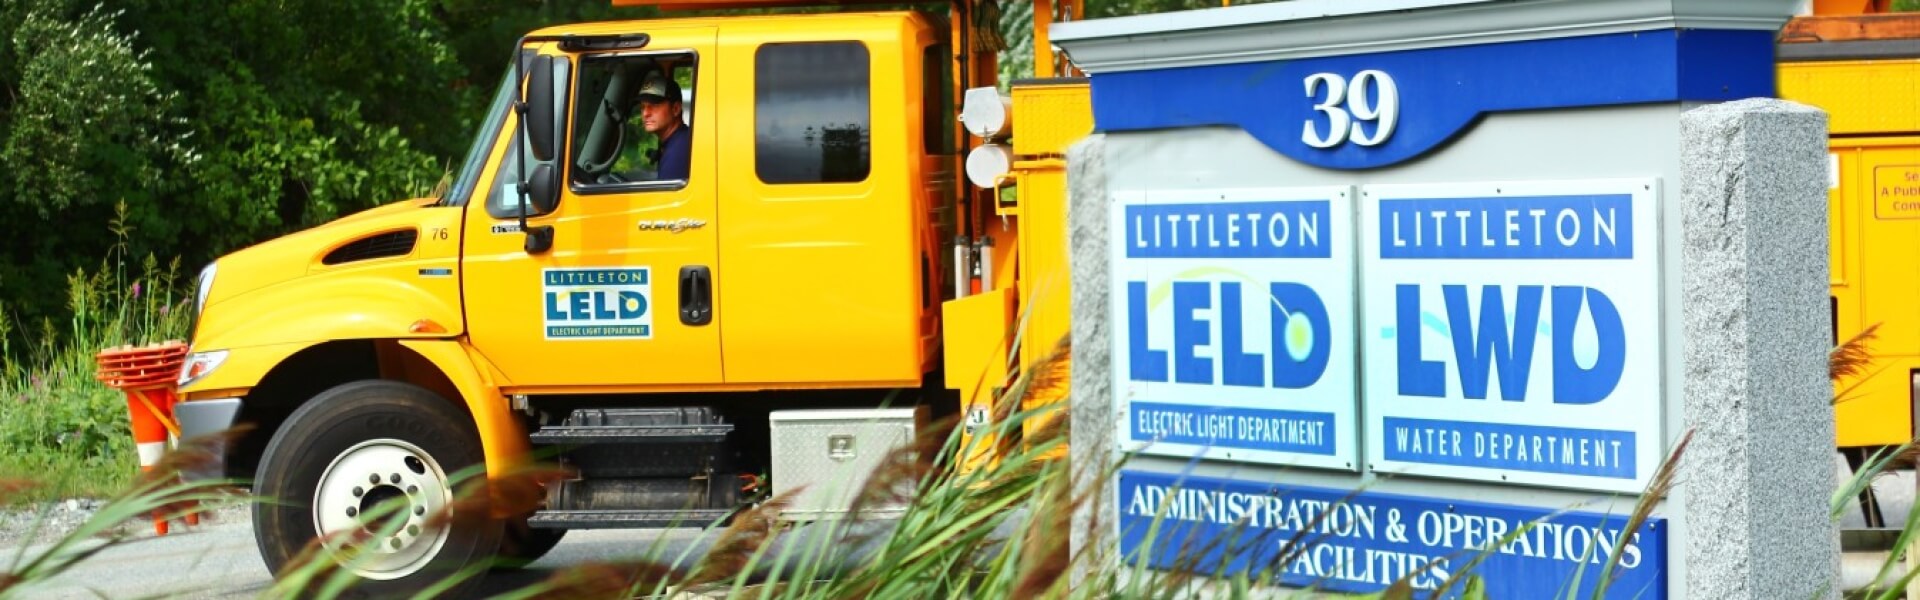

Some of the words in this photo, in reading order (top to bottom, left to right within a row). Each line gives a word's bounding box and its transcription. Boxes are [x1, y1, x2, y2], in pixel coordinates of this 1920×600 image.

[1302, 69, 1400, 148] 39
[1881, 187, 1889, 197] A
[432, 228, 449, 240] 76
[1136, 211, 1319, 248] LITTLETON
[1393, 207, 1617, 247] LITTLETON
[550, 272, 641, 283] LITTLETON
[546, 290, 647, 320] LELD
[552, 327, 580, 336] ELECTRIC
[582, 327, 601, 336] LIGHT
[603, 327, 644, 335] DEPARTMENT
[1127, 281, 1332, 389] LELD
[1396, 283, 1626, 405] LWD
[1138, 410, 1194, 437] ELECTRIC
[1197, 414, 1235, 440] LIGHT
[1238, 416, 1325, 446] DEPARTMENT
[1396, 426, 1462, 457] WATER
[1474, 431, 1622, 468] DEPARTMENT
[1129, 485, 1376, 540] ADMINISTRATION
[1385, 508, 1409, 543] &
[1417, 510, 1642, 569] OPERATIONS
